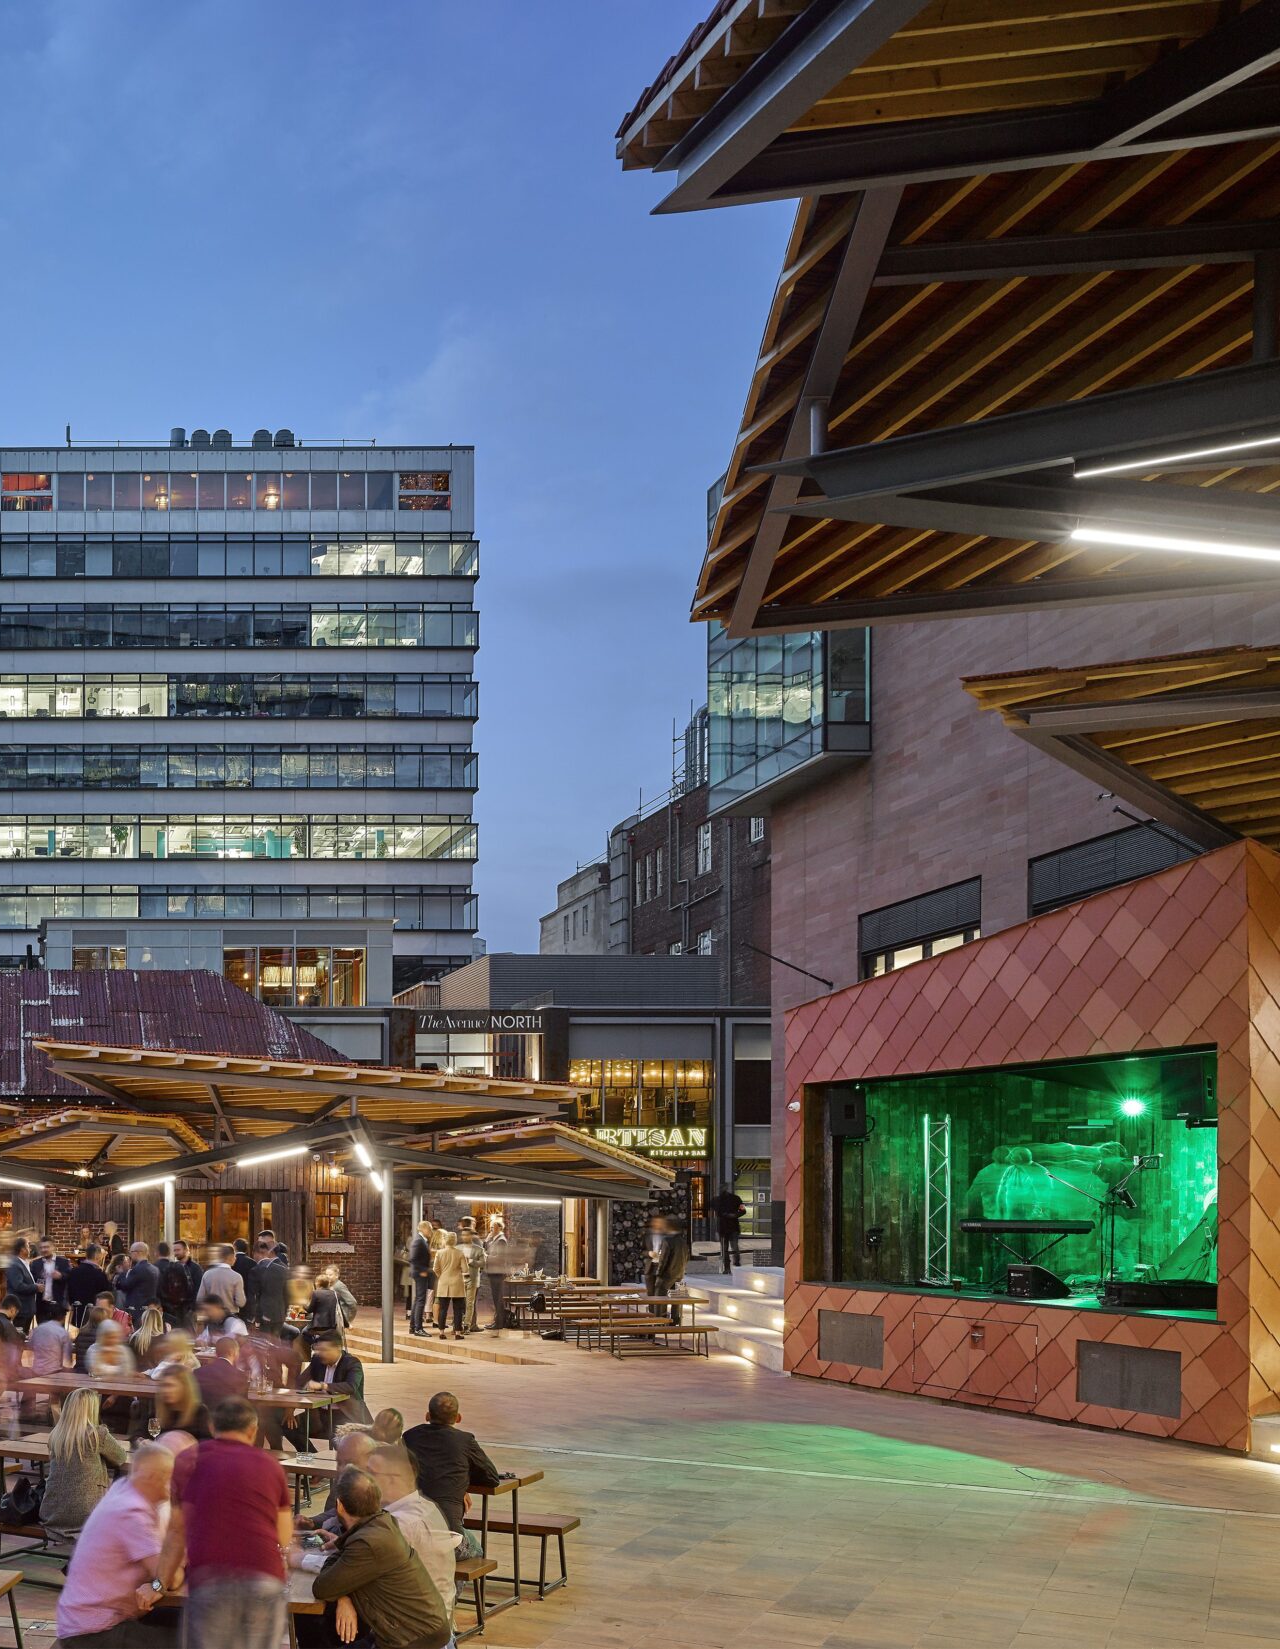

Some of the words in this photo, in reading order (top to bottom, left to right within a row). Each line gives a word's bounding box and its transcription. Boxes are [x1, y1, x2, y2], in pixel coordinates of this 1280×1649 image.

[419, 1014, 443, 1029] The
[491, 1015, 542, 1029] NORTH
[580, 1127, 708, 1147] RTISAN
[650, 1149, 684, 1157] KITCHEN
